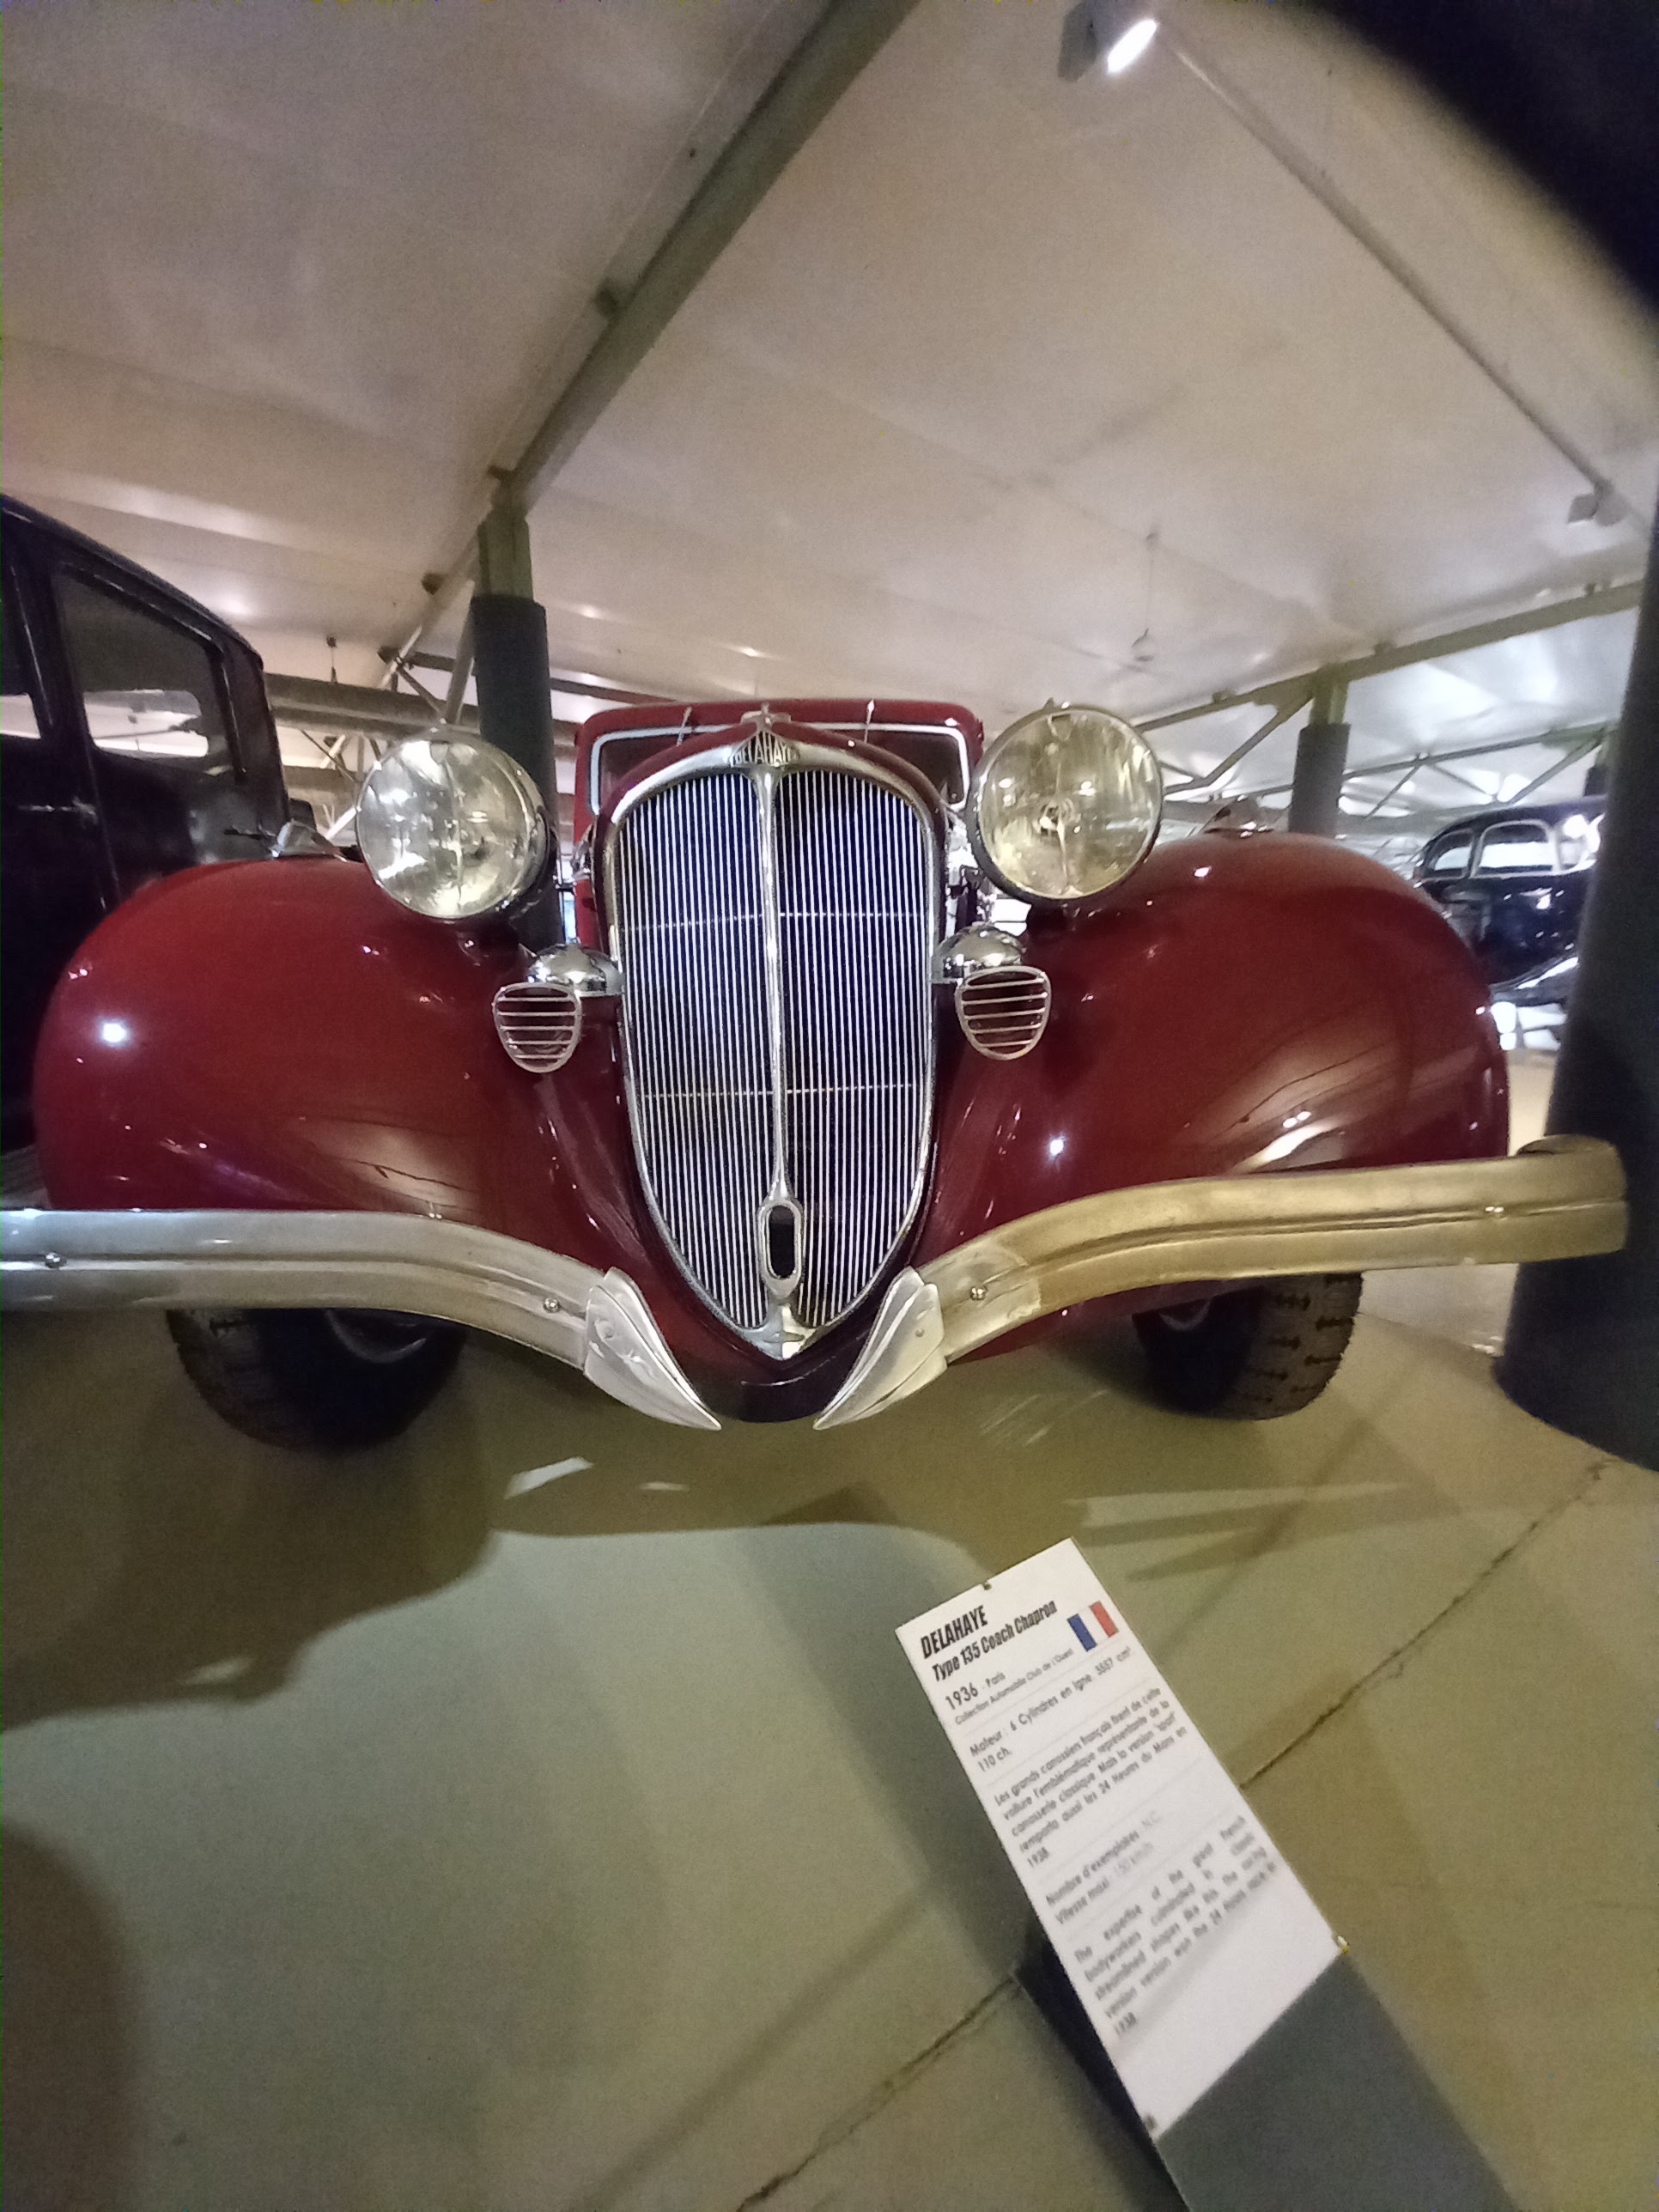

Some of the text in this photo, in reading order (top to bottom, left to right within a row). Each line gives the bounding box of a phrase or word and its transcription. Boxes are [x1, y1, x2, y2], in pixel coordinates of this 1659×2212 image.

[921, 1605, 988, 1659] DELAHAYE
[932, 1601, 1058, 1681] Type 135 Coach Chapron
[945, 1682, 978, 1710] 1936
[986, 1670, 1006, 1688] Paris
[969, 1730, 1003, 1757] Moteur
[978, 1753, 997, 1772] 110
